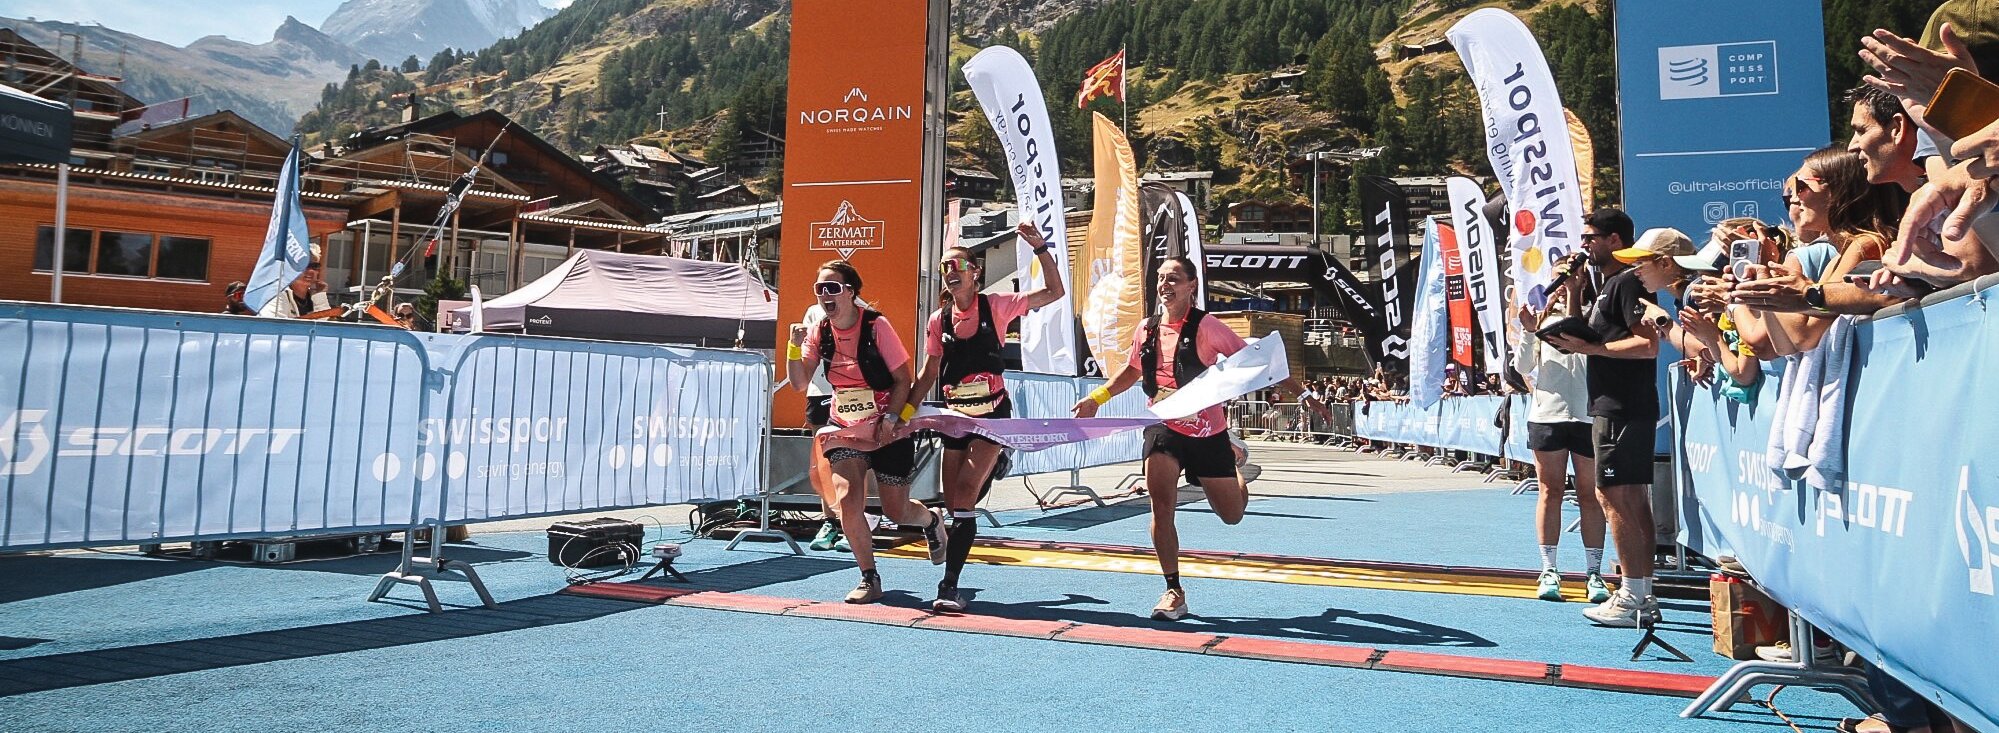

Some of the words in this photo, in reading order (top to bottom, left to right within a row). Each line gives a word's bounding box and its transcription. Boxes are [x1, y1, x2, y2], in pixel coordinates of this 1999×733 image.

[1729, 53, 1763, 62] COMP
[1730, 64, 1763, 73] RESS
[1730, 76, 1763, 84] PORT
[800, 105, 912, 124] NORQAIN
[1668, 178, 1785, 195] @ultraksofficial
[818, 226, 876, 239] ZERMATT
[822, 239, 871, 247] MATTERHORN
[1206, 254, 1307, 268] SCOTT
[1335, 278, 1375, 317] SCOT
[837, 401, 875, 413] 6503.3
[417, 407, 568, 452] swisspor
[633, 408, 739, 446] swisspor
[57, 427, 307, 456] SCOTT
[477, 460, 520, 481] saving
[524, 460, 567, 479] energy
